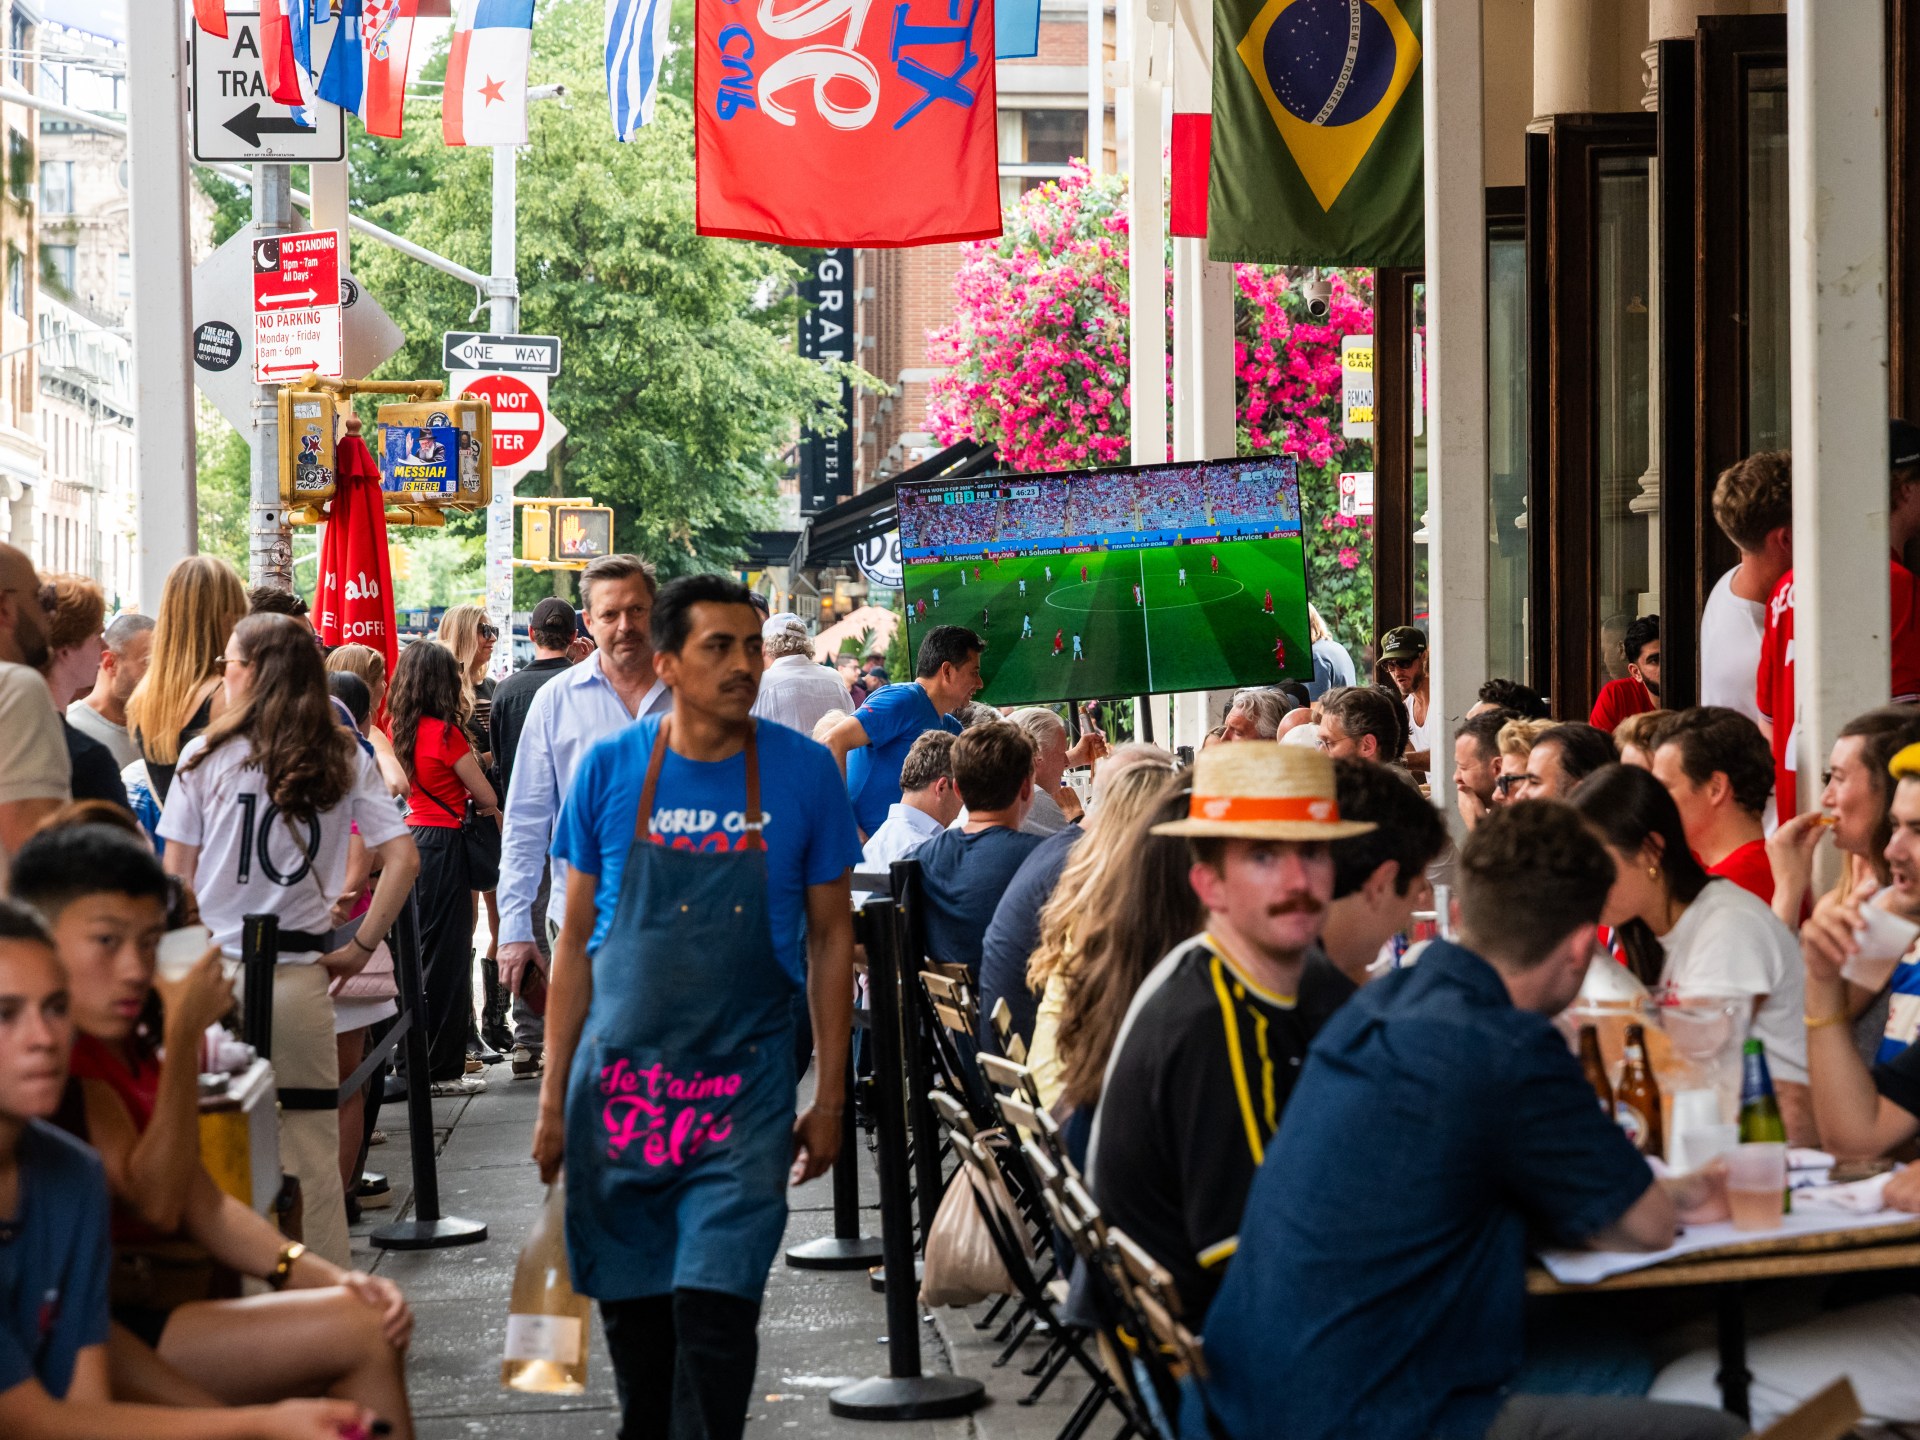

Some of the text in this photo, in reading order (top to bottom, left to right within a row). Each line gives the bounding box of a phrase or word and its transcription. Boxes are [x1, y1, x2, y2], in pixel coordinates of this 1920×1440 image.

[1351, 0, 1360, 40] ORDEM
[1317, 58, 1354, 122] PROGRESSO
[282, 237, 335, 254] NO STANDING
[282, 260, 299, 270] 11pm
[304, 257, 318, 268] 7am
[282, 271, 309, 282] All Days
[260, 311, 320, 328] NO PARKING
[200, 332, 234, 346] UNIVERSE
[204, 326, 234, 338] THE CLAY
[260, 332, 290, 344] Monday
[297, 330, 320, 342] Friday
[260, 348, 276, 358] 8am
[284, 346, 302, 358] 6pm
[464, 346, 545, 362] ONE WAY
[196, 354, 228, 365] NEW YORK
[496, 392, 528, 408] NOT
[492, 434, 524, 450] TER
[394, 466, 446, 478] MESSIAH
[1266, 470, 1286, 480] FOX
[404, 482, 438, 490] IS HERE!
[928, 494, 942, 502] NOR
[1016, 488, 1036, 496] 46:23
[237, 794, 320, 886] 10
[600, 1058, 742, 1099] Je t'aime
